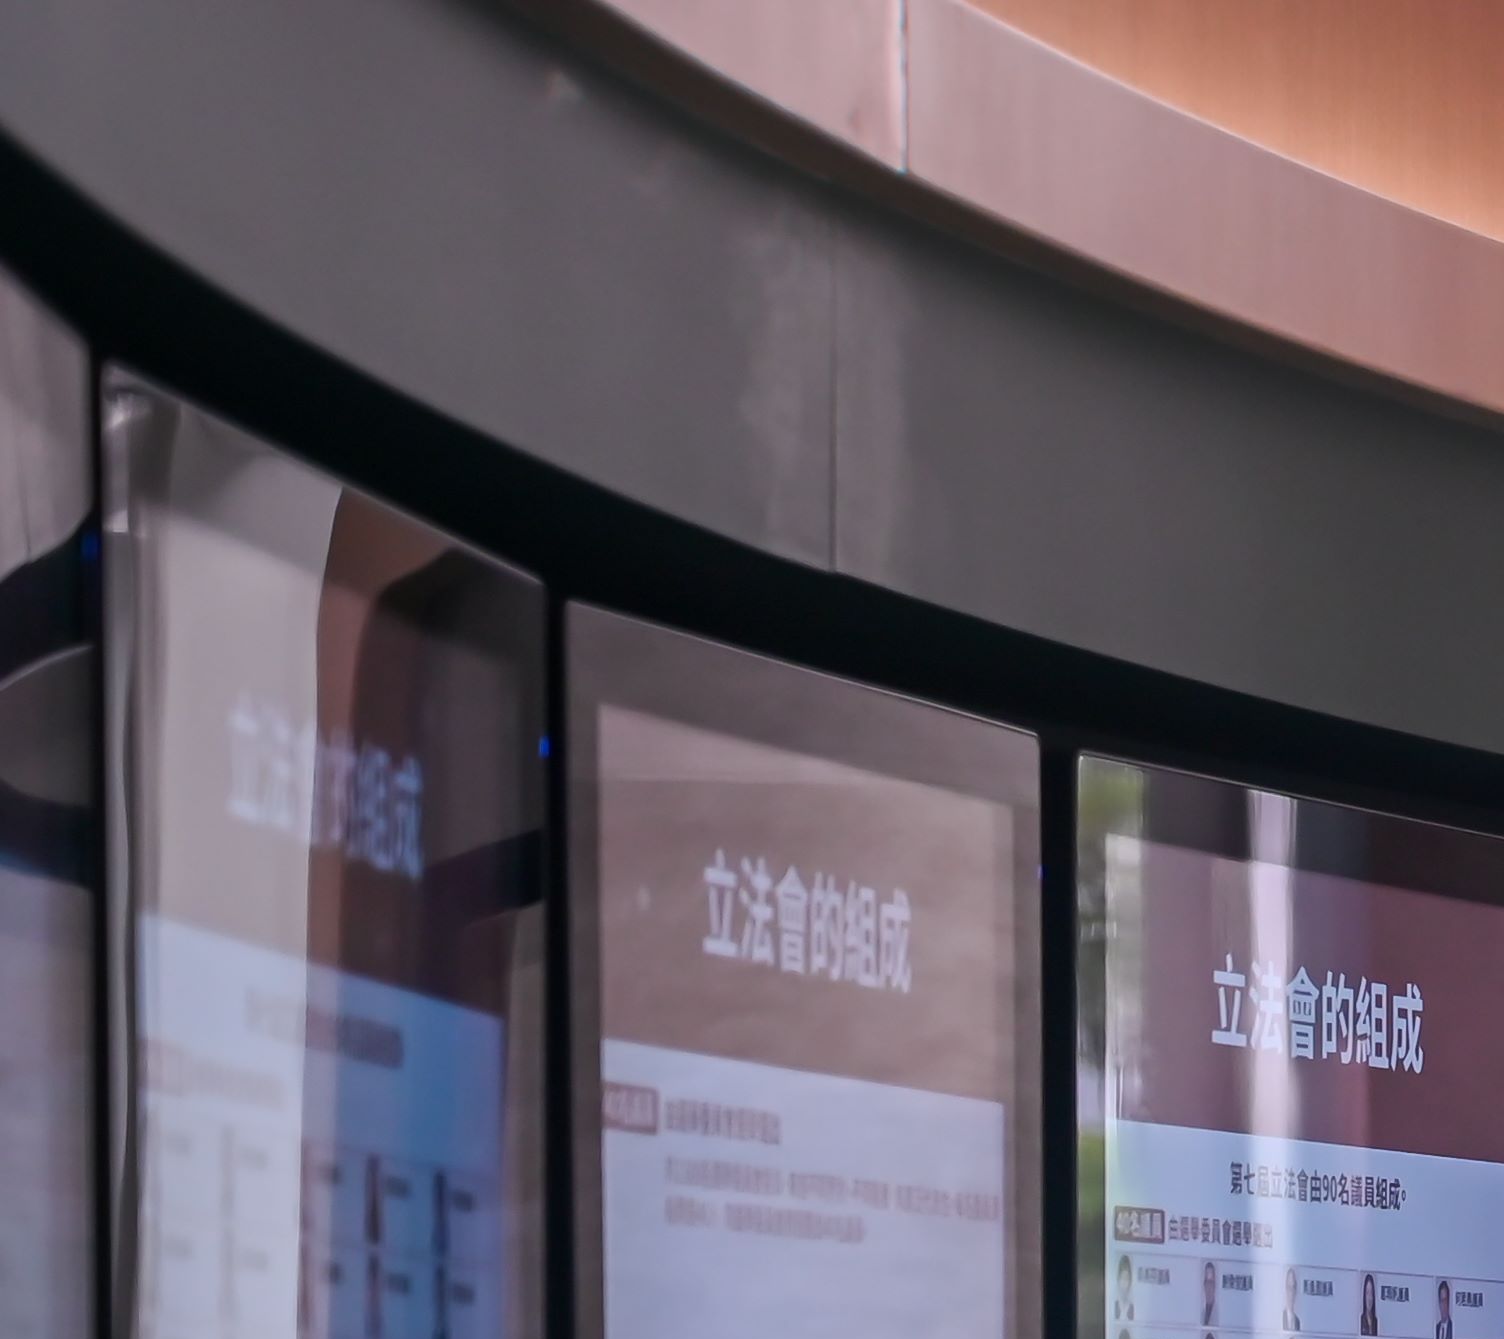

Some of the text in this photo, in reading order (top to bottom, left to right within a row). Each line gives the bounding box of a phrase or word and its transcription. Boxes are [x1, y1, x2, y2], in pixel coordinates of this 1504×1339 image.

[703, 847, 912, 992] 立法會的組成
[1211, 953, 1424, 1074] 立法會的組成
